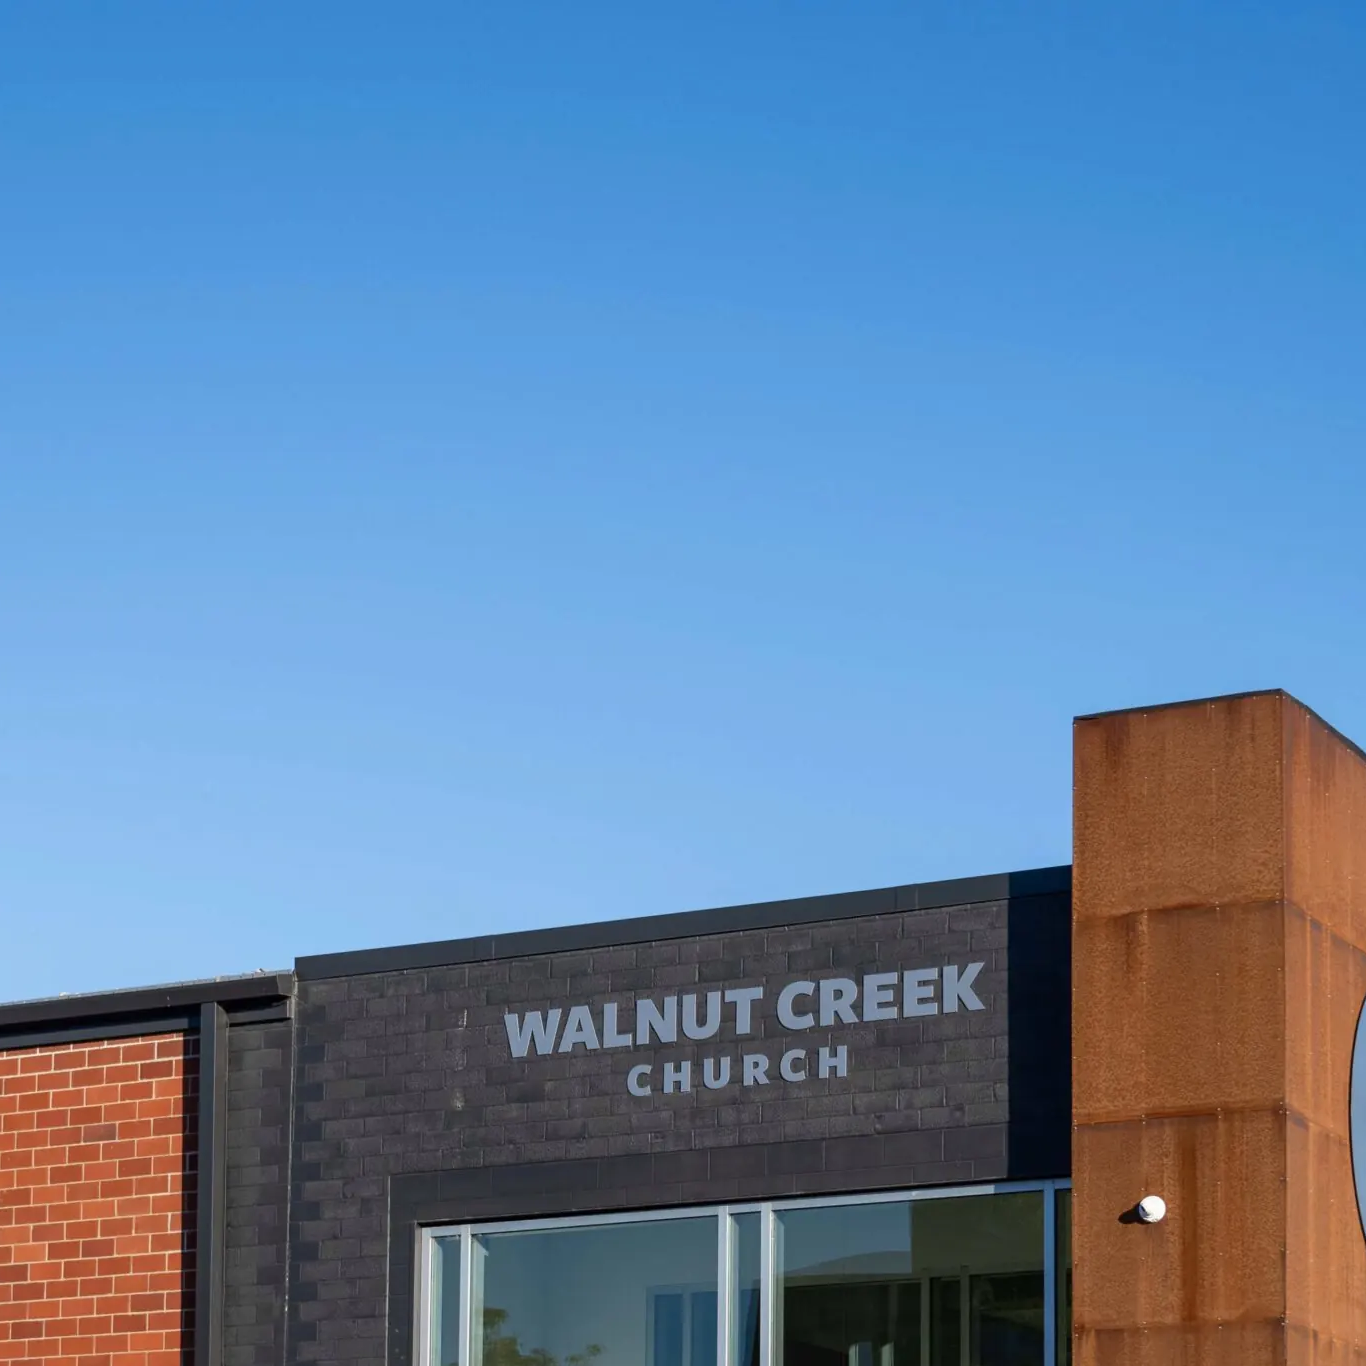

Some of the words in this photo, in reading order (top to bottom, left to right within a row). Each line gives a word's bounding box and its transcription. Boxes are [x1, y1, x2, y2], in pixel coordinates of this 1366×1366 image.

[503, 986, 764, 1059] WALNUT
[776, 961, 986, 1030] CREEK
[627, 1045, 848, 1097] CHURCH
